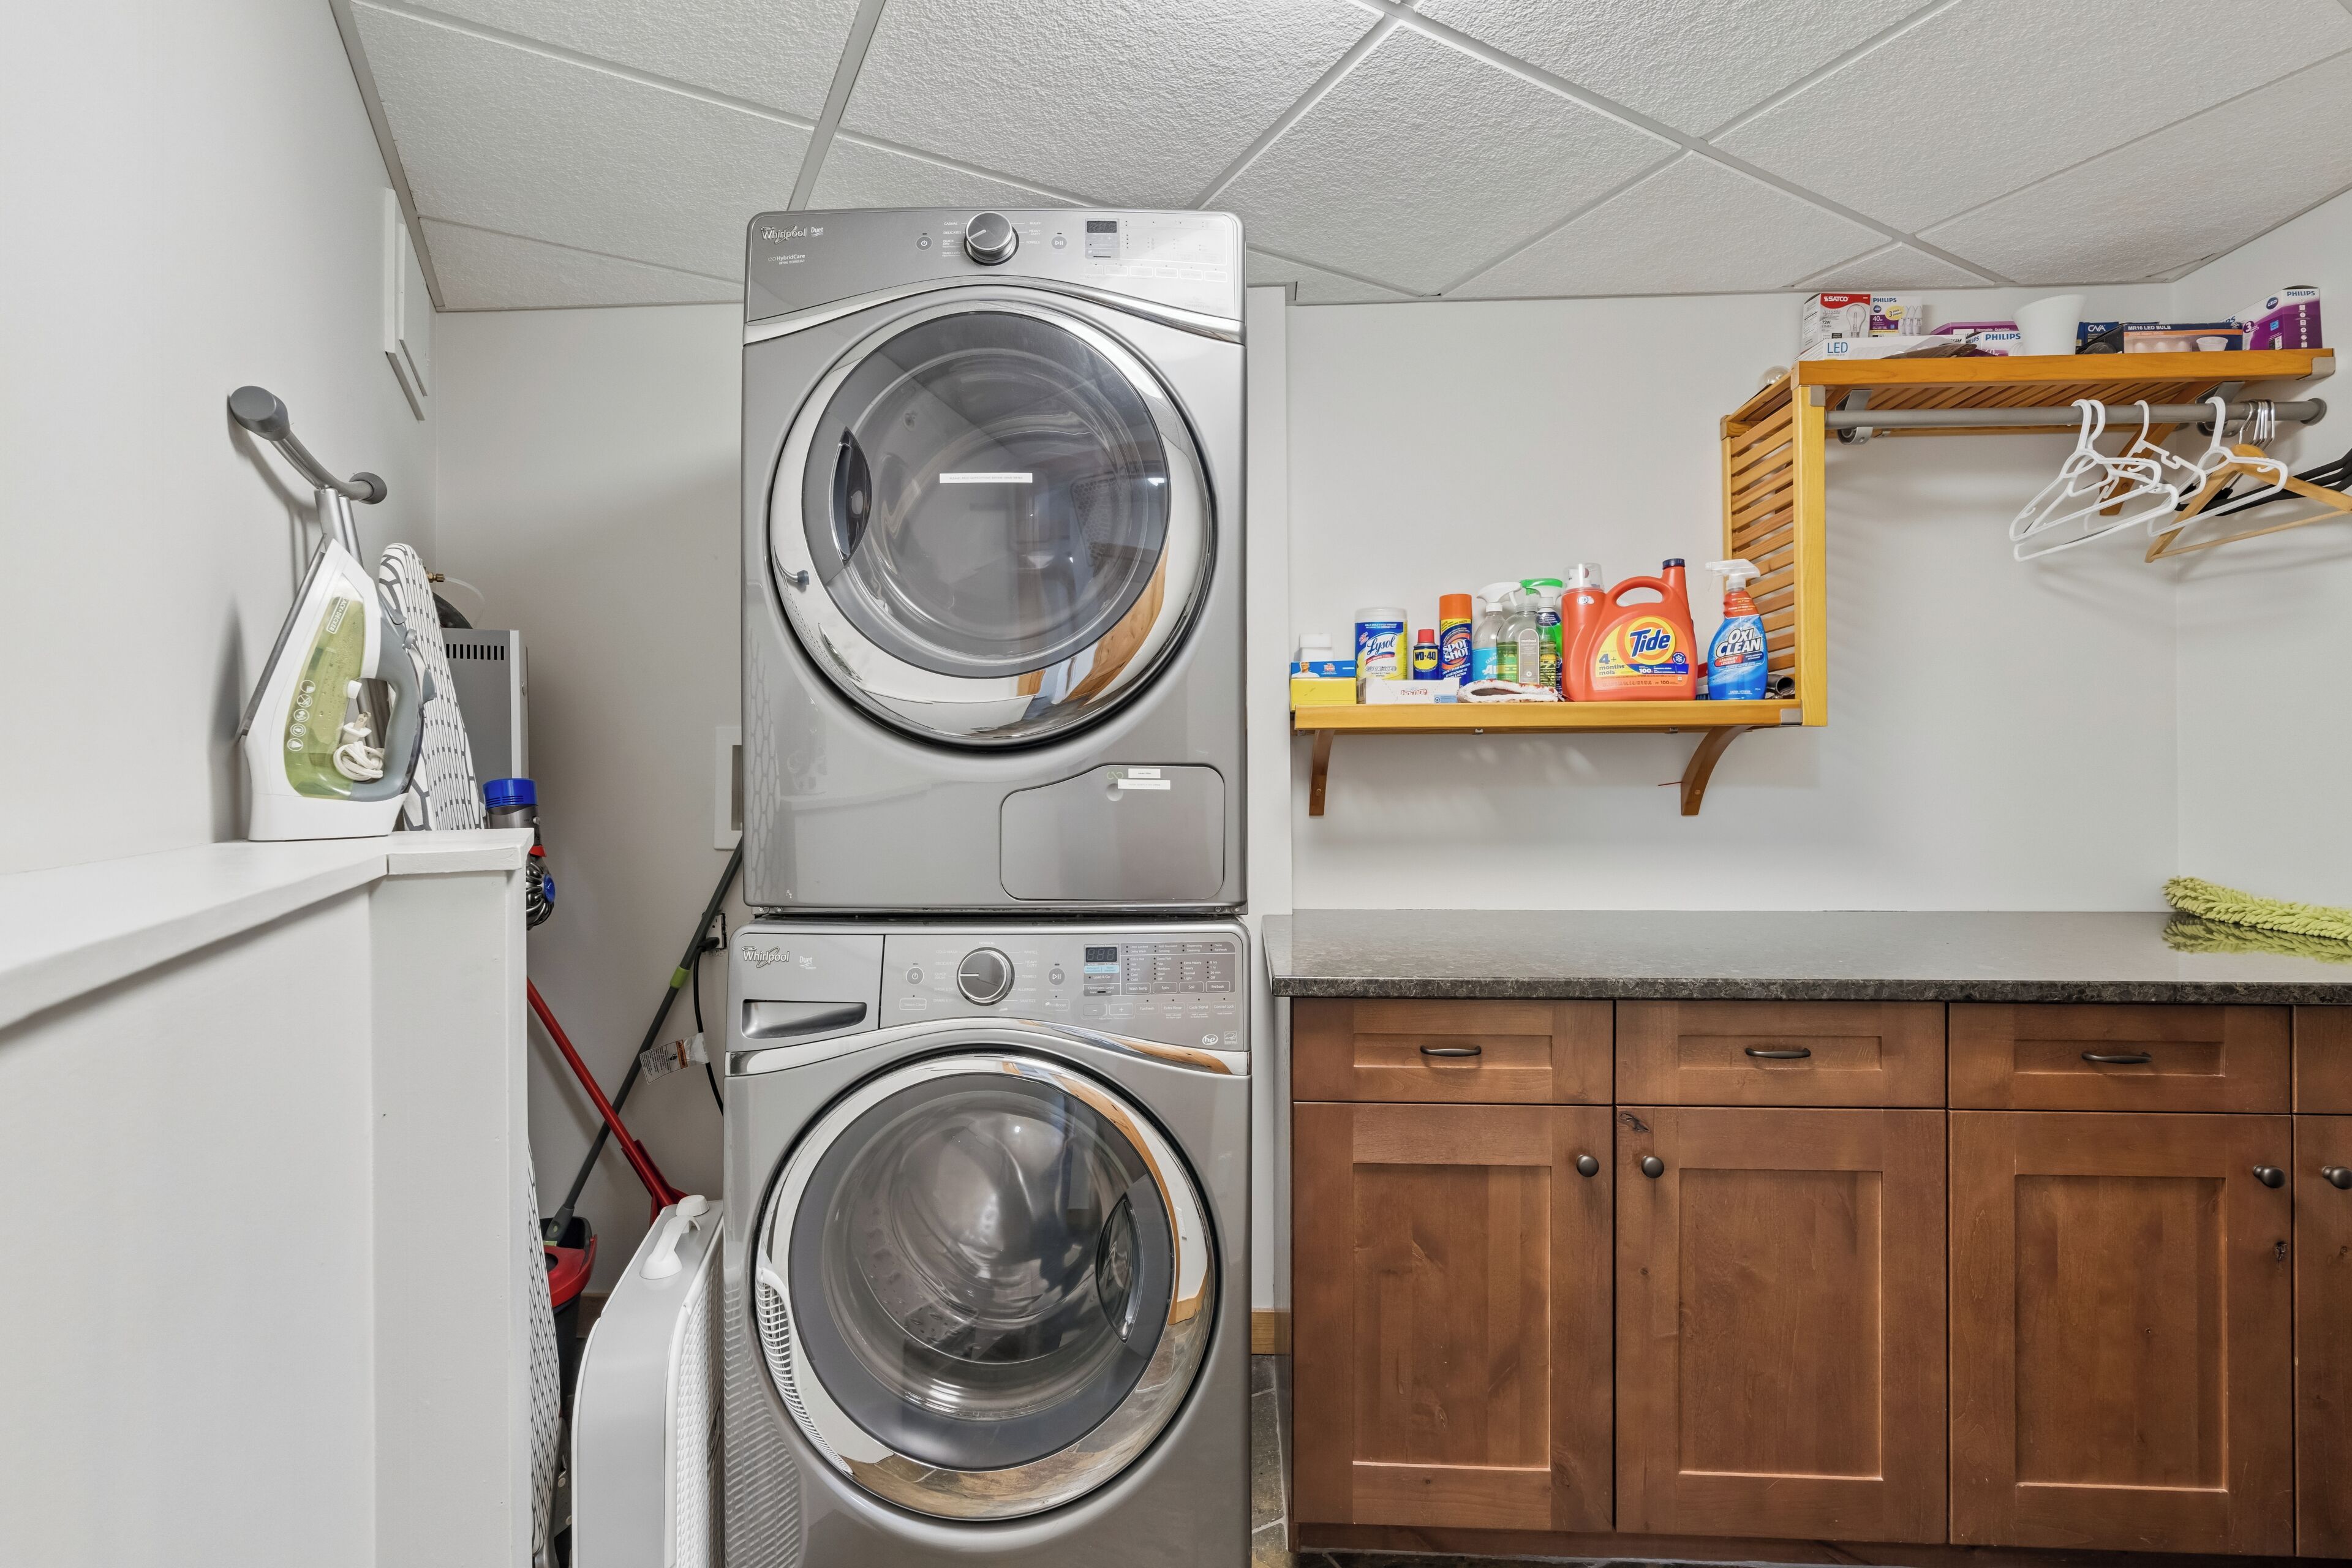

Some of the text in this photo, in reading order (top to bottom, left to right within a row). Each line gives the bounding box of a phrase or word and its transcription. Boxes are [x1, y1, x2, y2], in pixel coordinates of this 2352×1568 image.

[761, 227, 807, 241] Whirlpool
[777, 254, 805, 262] HybridCare
[2245, 322, 2252, 332] 3
[1828, 342, 1848, 353] LED
[328, 597, 349, 631] ACK+DECKER
[1727, 627, 1755, 644] OXI
[1366, 635, 1396, 655] Lysol
[1442, 638, 1468, 654] SPOT
[1629, 628, 1671, 658] Tide
[1716, 637, 1762, 658] CLEAN
[1415, 651, 1436, 661] WD-40
[1444, 647, 1470, 662] SHOT
[743, 951, 790, 965] Whirlpool
[1204, 1035, 1216, 1045] he
